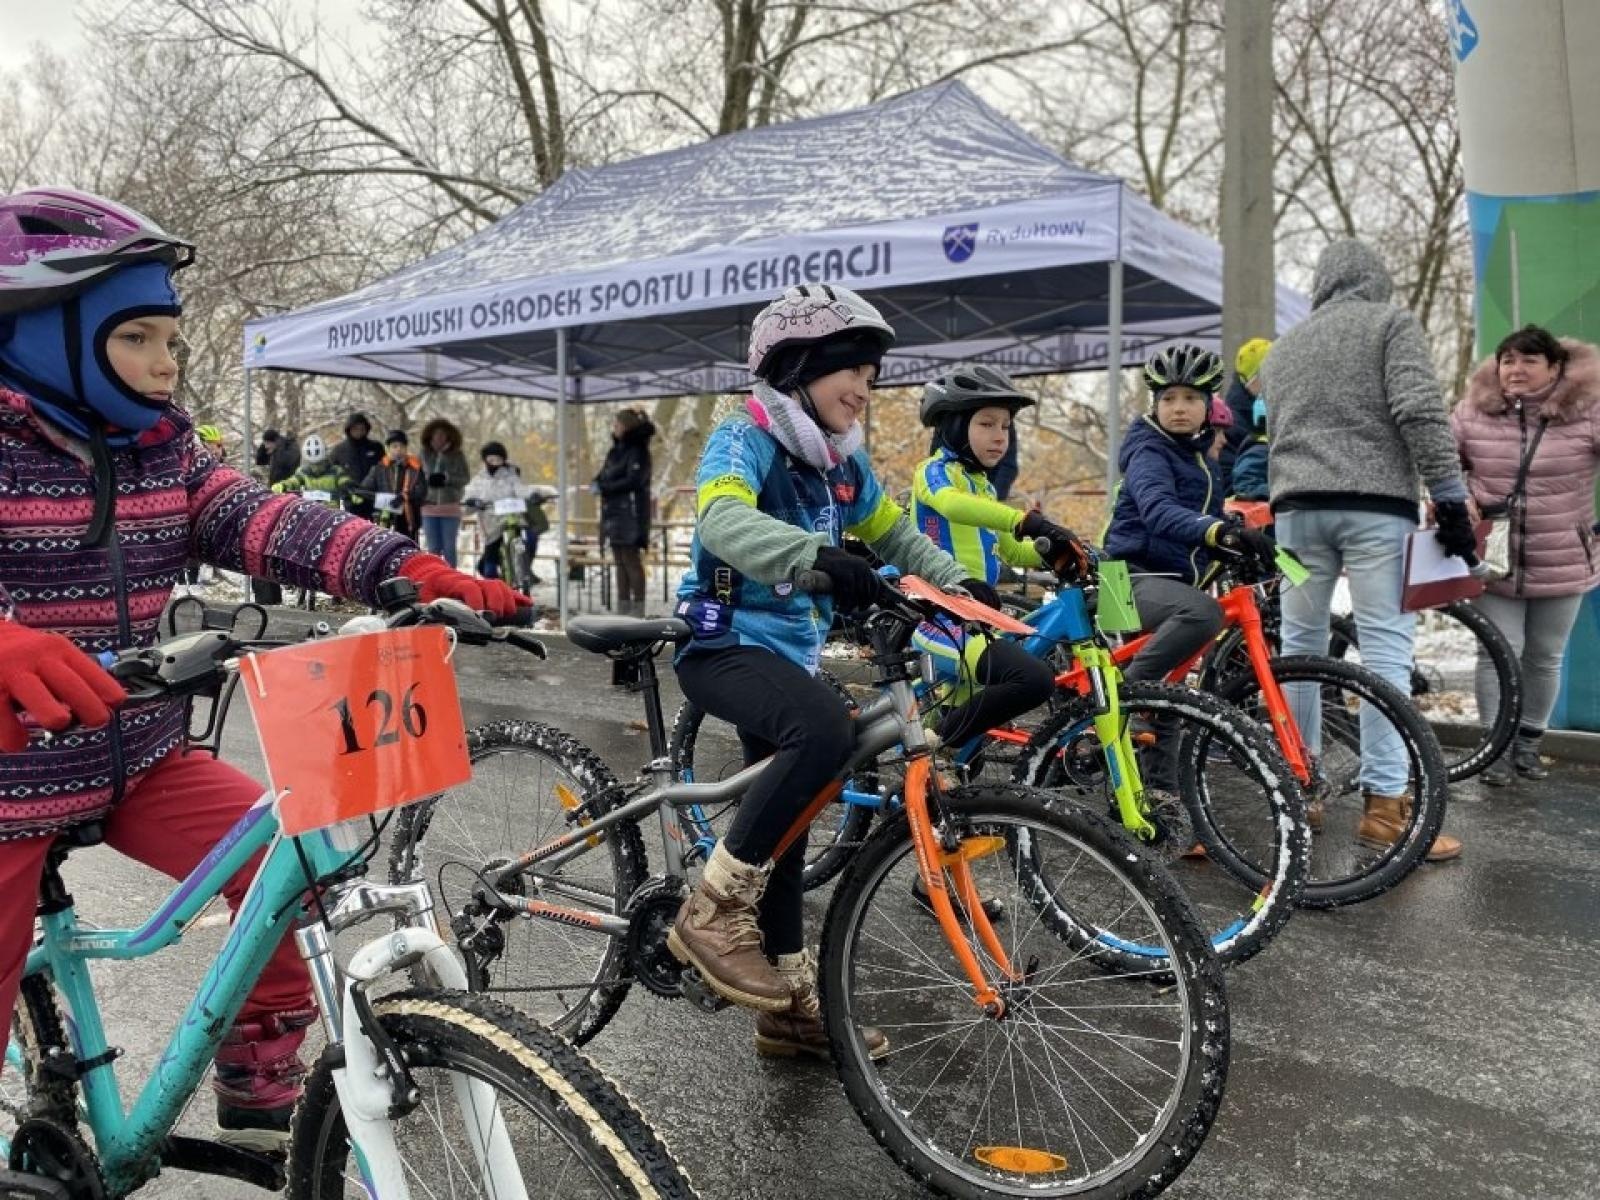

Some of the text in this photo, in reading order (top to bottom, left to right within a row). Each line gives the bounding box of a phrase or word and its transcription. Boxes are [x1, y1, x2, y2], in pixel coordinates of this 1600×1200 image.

[327, 240, 892, 349] RYDUŁTOWSKI OŚRODEK SPORTU I REKREACJI
[329, 681, 428, 756] 126
